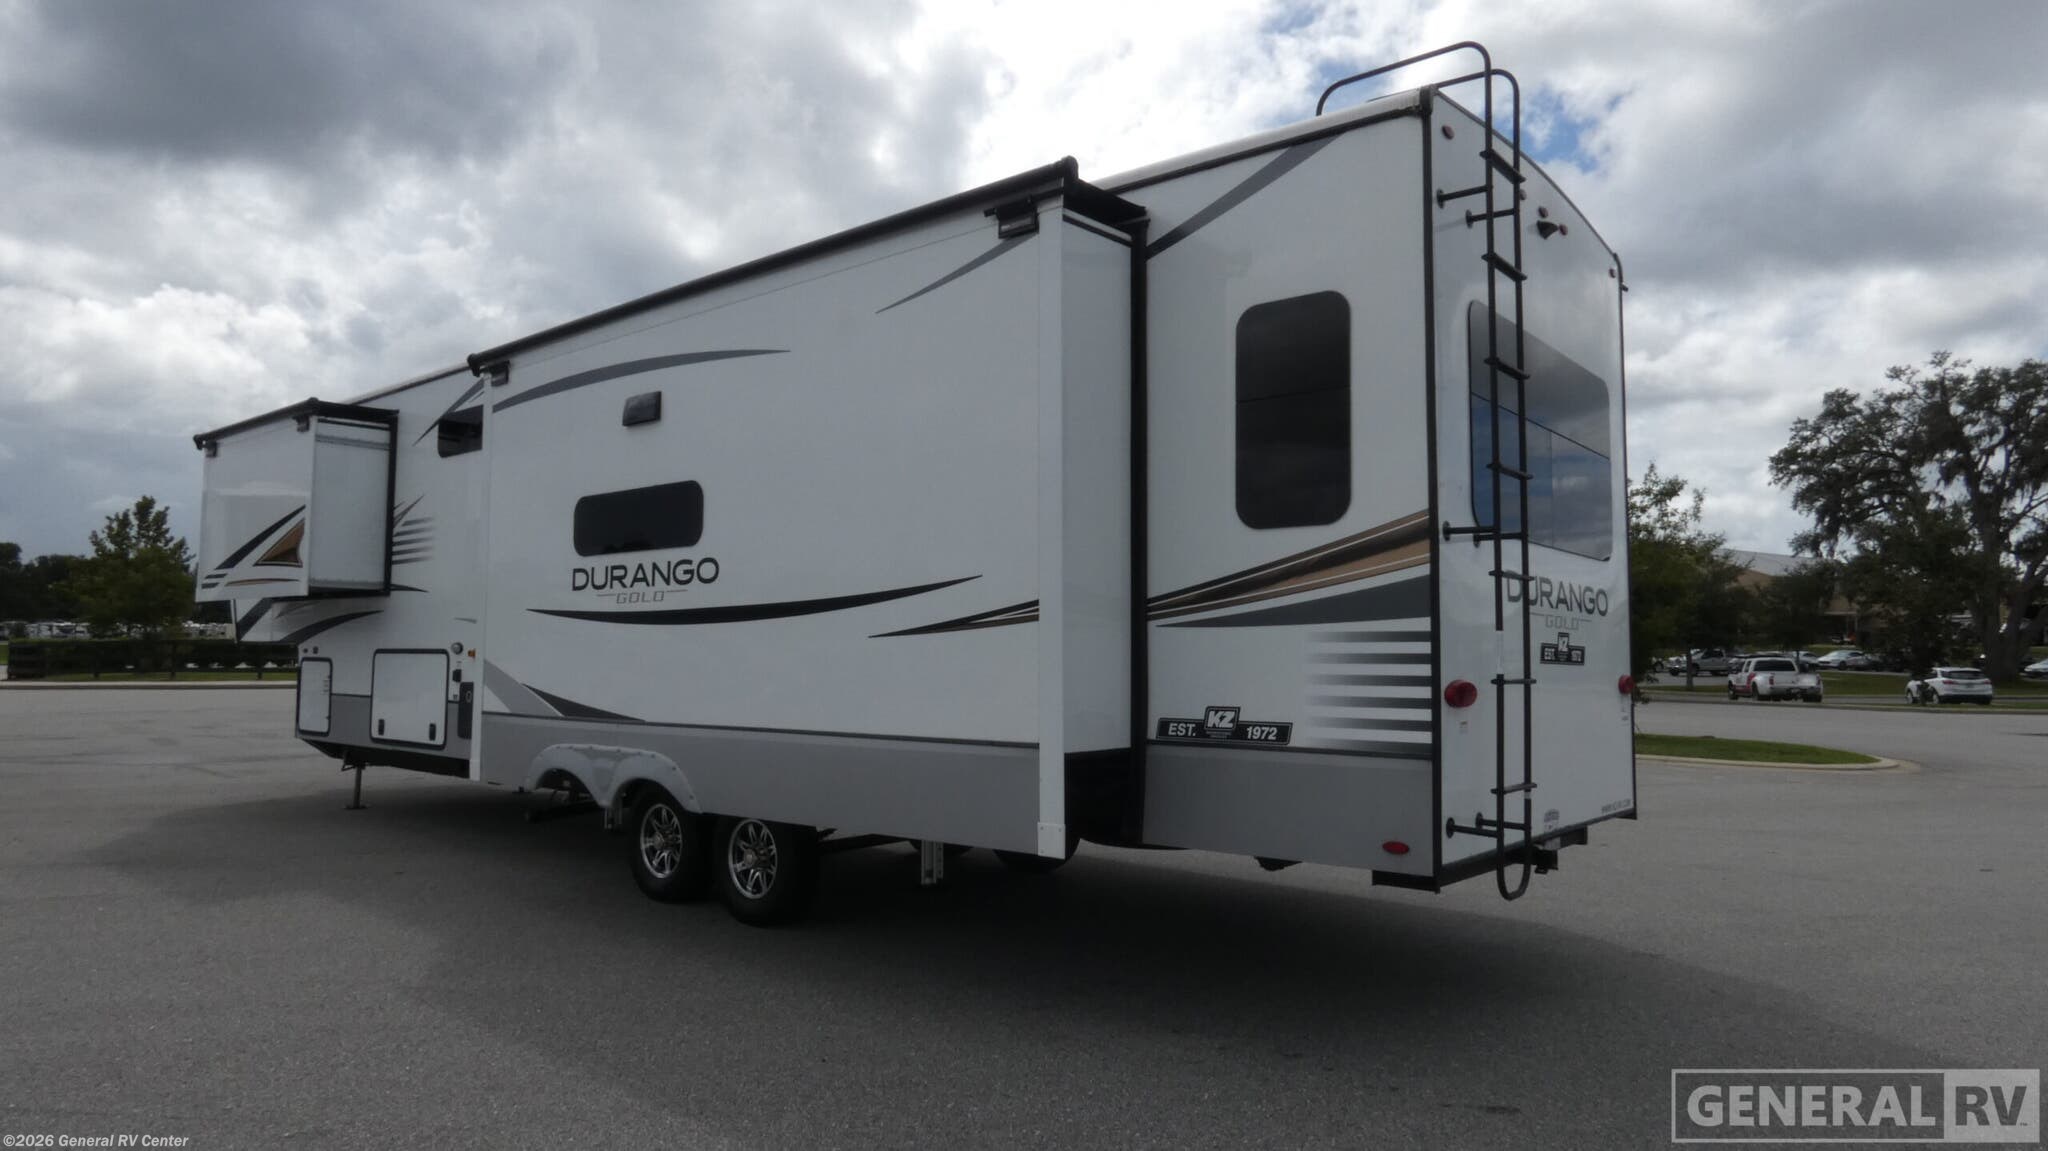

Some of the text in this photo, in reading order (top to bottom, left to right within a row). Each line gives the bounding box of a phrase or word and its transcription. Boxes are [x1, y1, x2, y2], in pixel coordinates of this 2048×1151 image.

[572, 557, 720, 591] DURANGO
[616, 591, 664, 604] GOLD
[1545, 615, 1580, 630] GOLD
[1207, 710, 1236, 728] KZ
[1168, 723, 1196, 737] EST.
[1246, 726, 1278, 741] 1972
